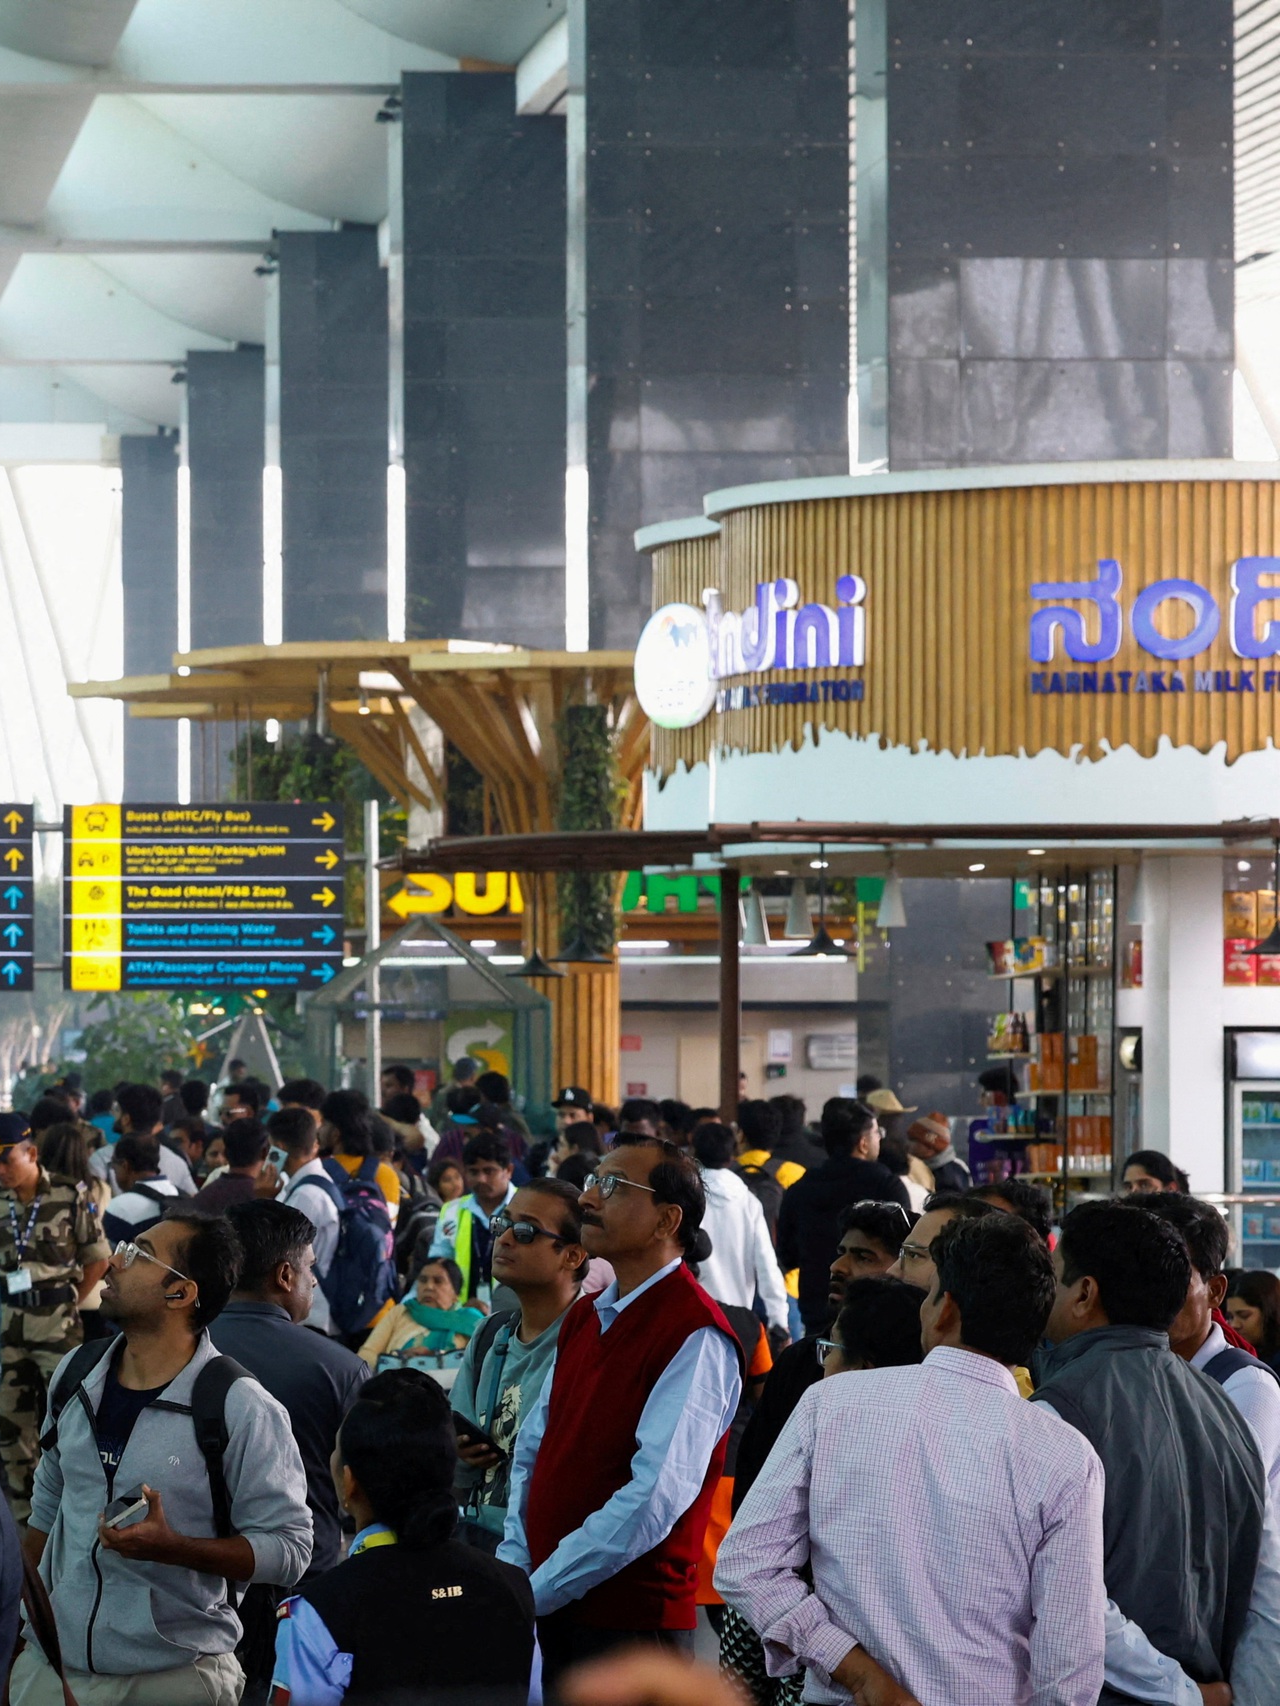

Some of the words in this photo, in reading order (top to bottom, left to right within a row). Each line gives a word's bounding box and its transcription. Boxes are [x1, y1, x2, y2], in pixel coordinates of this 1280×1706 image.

[1030, 670, 1186, 694] KARNATAKA
[1194, 670, 1255, 693] MILK
[125, 810, 159, 822] Buses
[161, 810, 223, 823] (BMTC/Fly
[224, 811, 251, 822] Bus)
[125, 845, 185, 857] Uber/Quick
[126, 886, 149, 898] The
[150, 885, 182, 898] Quad
[183, 885, 250, 899] (Retail/F&B
[252, 885, 286, 898] Zone)
[126, 923, 165, 936] Toilets
[166, 923, 189, 935] and
[190, 923, 239, 937] Drinking
[240, 923, 276, 936] Water
[126, 961, 215, 974] ATM/Passenger
[216, 961, 267, 975] Courtesy
[269, 961, 306, 973] Phone
[431, 1585, 463, 1600] S&IB
